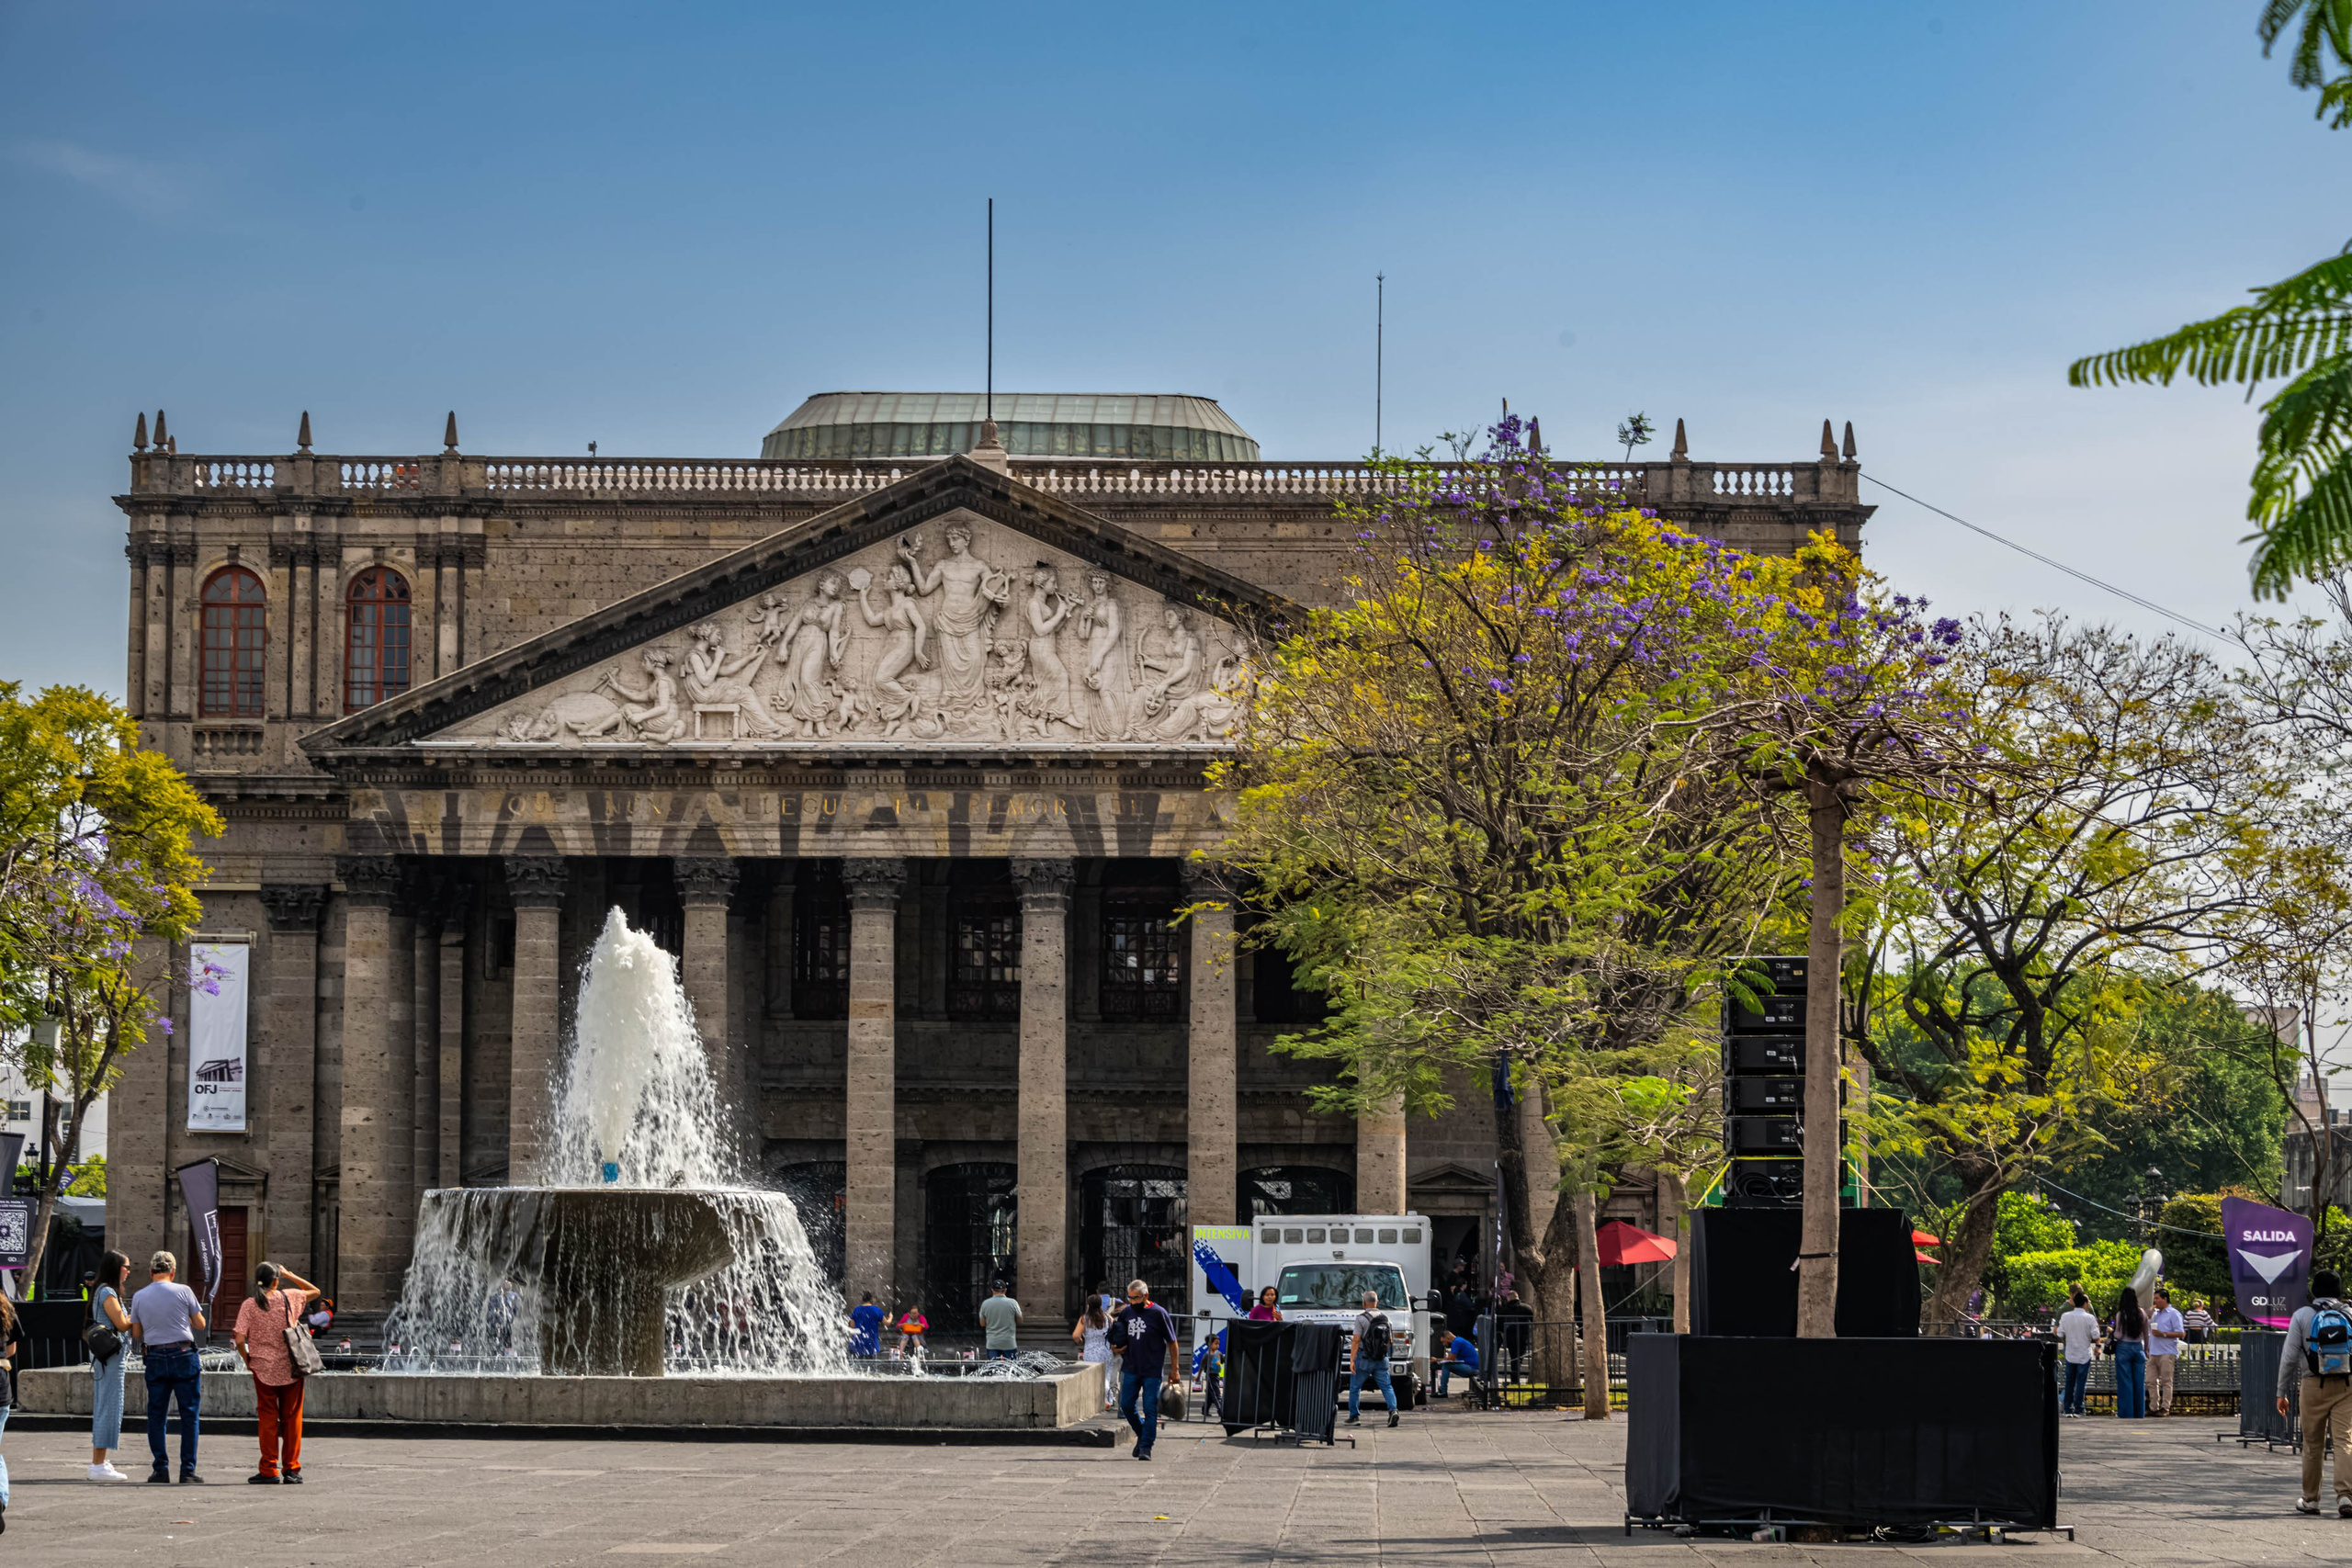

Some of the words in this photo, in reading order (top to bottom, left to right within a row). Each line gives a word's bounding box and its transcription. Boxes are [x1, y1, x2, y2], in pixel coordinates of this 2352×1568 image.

[508, 795, 567, 816] QUE
[195, 1084, 217, 1094] OFJ
[1194, 1228, 1250, 1239] INTENSIVA
[2243, 1230, 2296, 1242] SALIDA
[2251, 1296, 2286, 1306] GDLUZ
